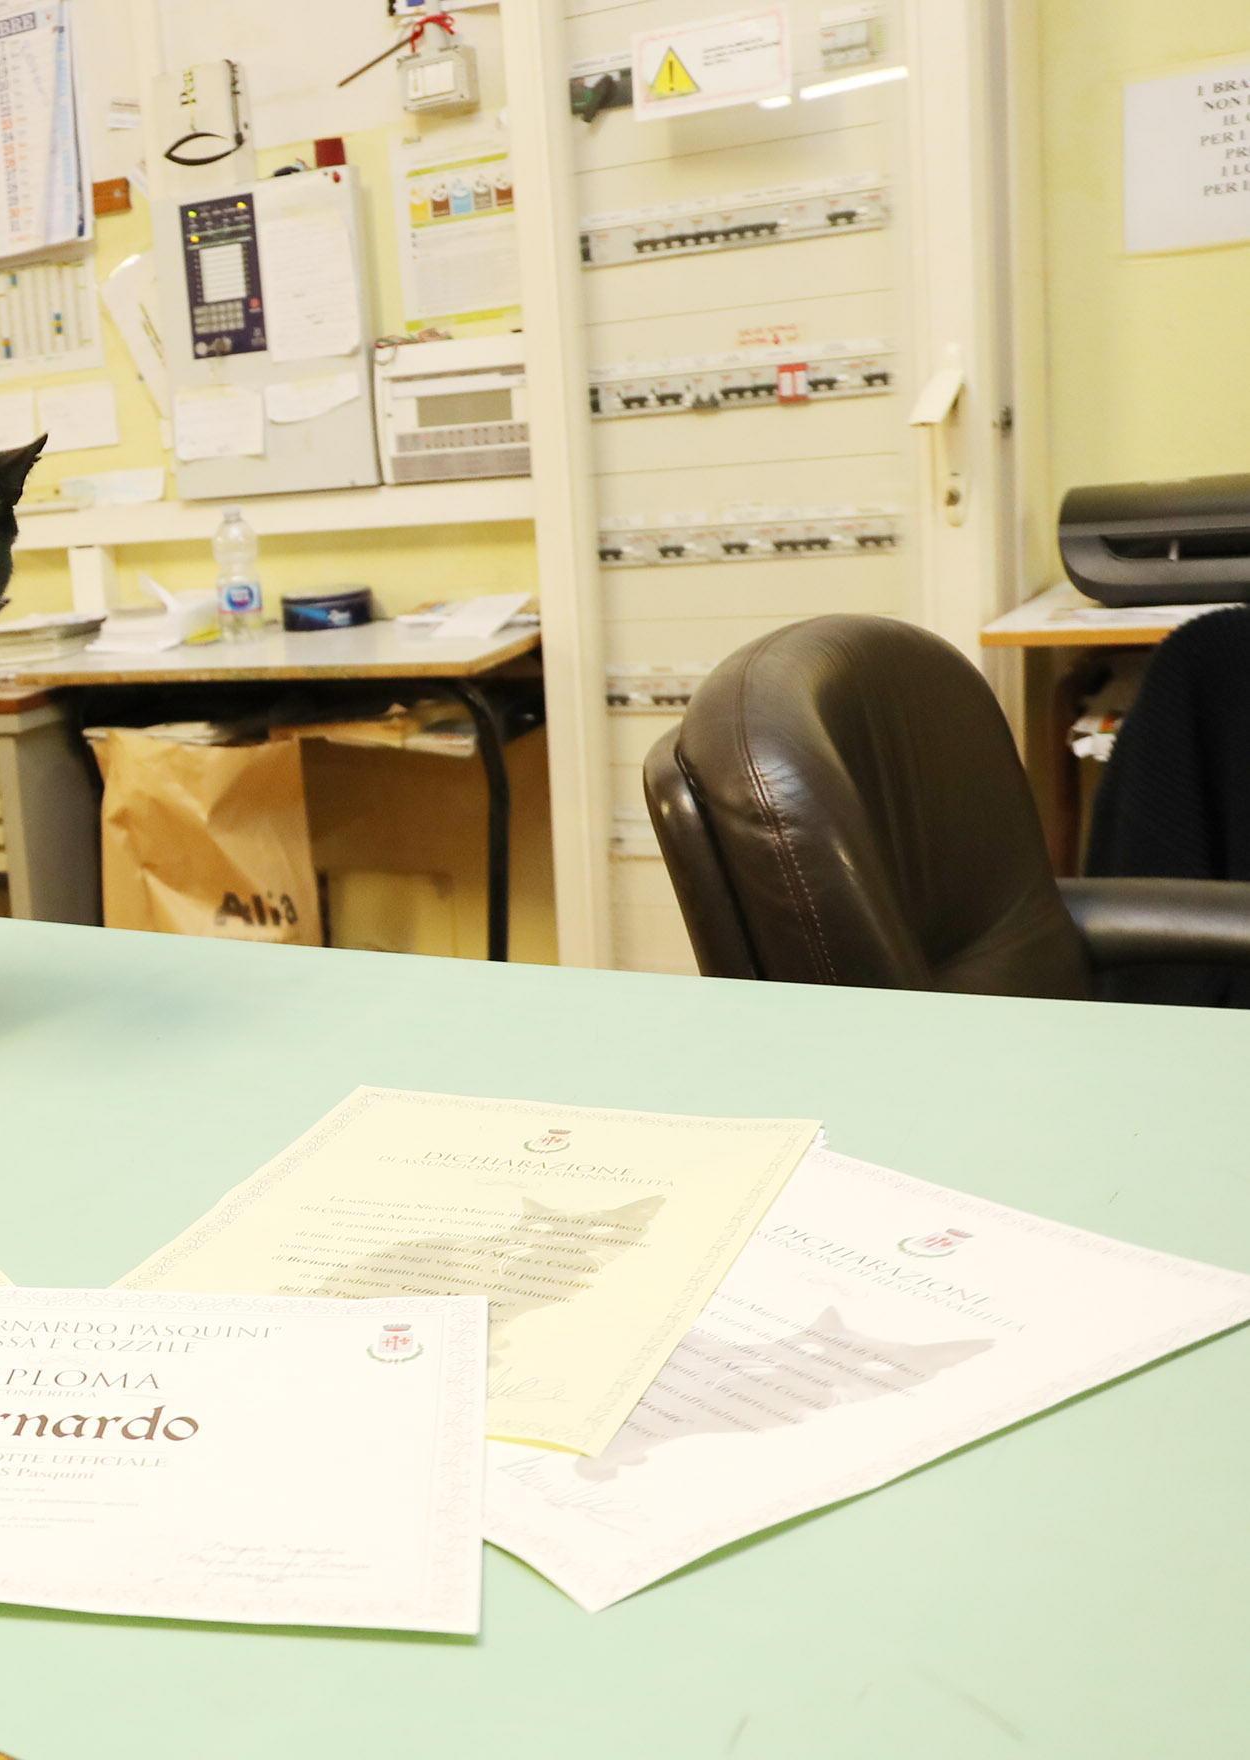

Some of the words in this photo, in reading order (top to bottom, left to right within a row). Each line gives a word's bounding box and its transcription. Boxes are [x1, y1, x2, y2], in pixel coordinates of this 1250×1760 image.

[1213, 80, 1250, 93] BRA
[1200, 131, 1234, 146] PER
[1225, 147, 1250, 159] PR
[1203, 182, 1238, 196] PER
[214, 889, 298, 926] Alia
[424, 1151, 632, 1175] DICHIARAZIONE
[773, 1225, 990, 1305] DICHIARAZIONE
[128, 1322, 283, 1341] PASQUINI"
[71, 1338, 200, 1354] COZZILE
[51, 1453, 169, 1469] UFFICIALE
[15, 1467, 96, 1480] Pasquini
